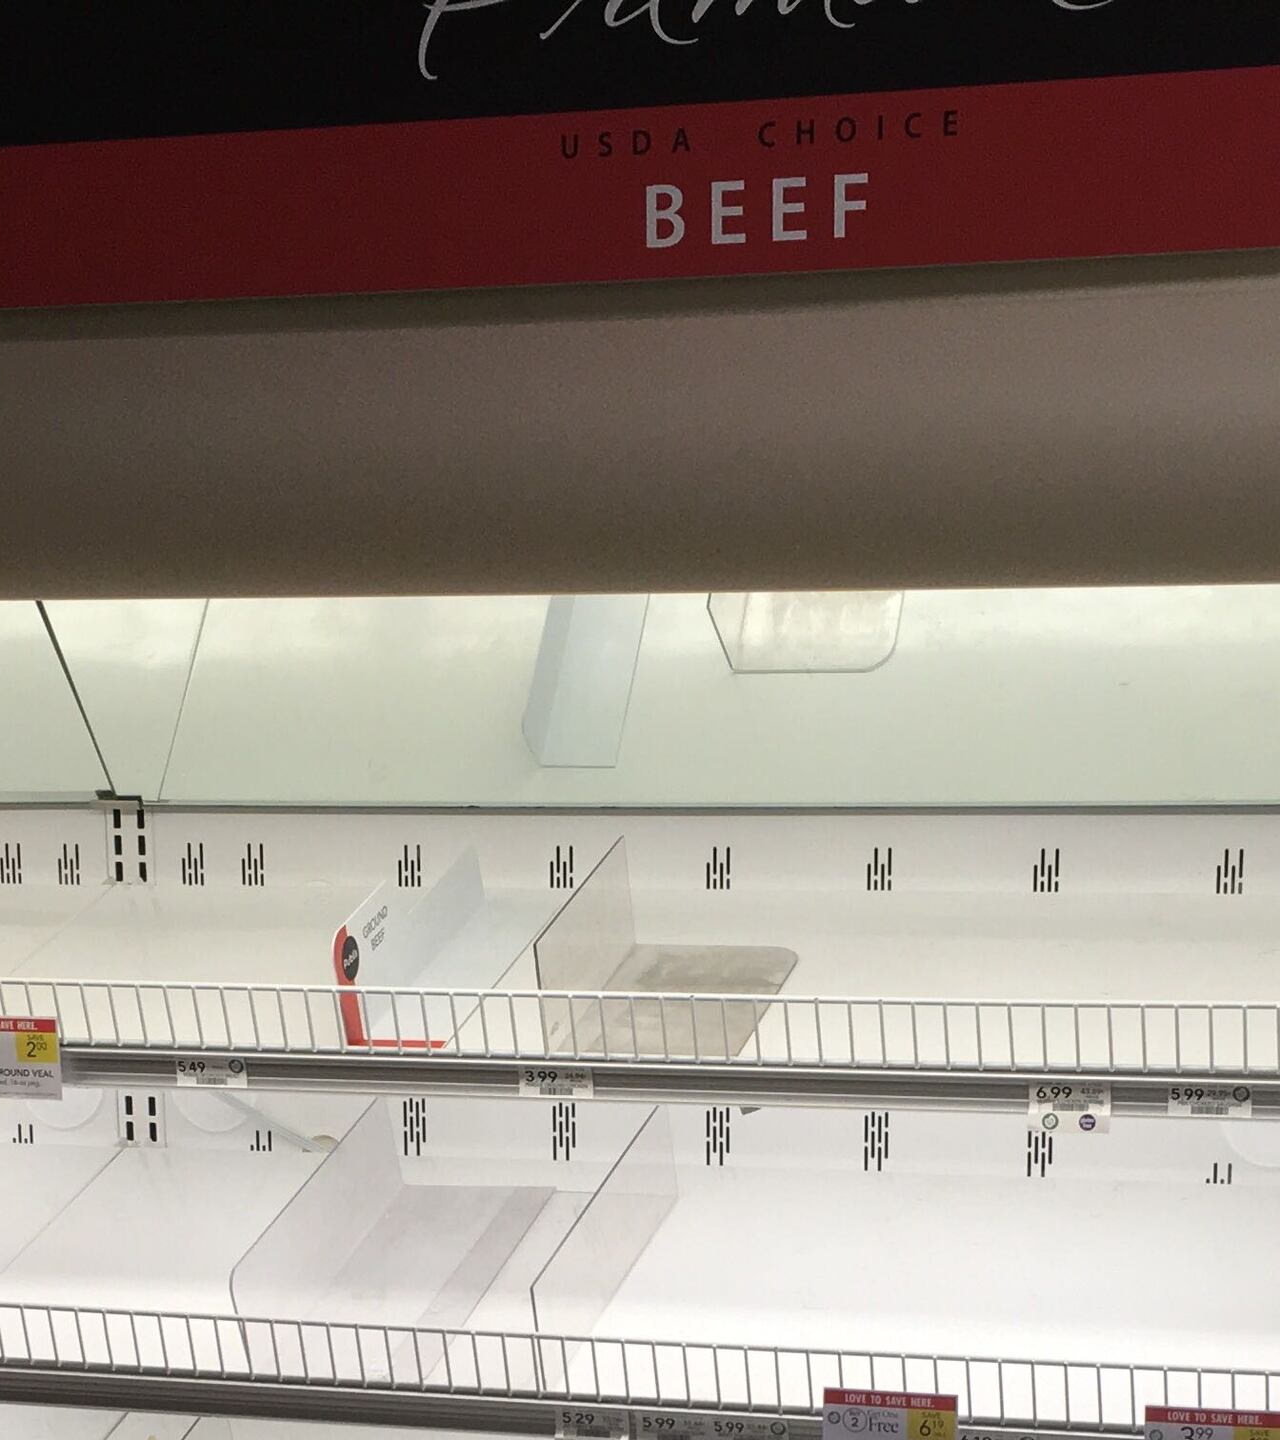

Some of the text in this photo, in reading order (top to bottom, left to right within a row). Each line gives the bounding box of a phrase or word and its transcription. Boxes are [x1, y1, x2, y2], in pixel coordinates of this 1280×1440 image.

[561, 110, 960, 159] USDA CHOICE
[646, 172, 870, 249] BEEF
[17, 1021, 38, 1030] HERE.
[32, 1068, 54, 1078] VEAL
[845, 1393, 935, 1408] LOVE TO SAVE HERE.
[851, 1416, 859, 1428] 2
[1167, 1411, 1263, 1425] LOVE TO SAVE HERE.
